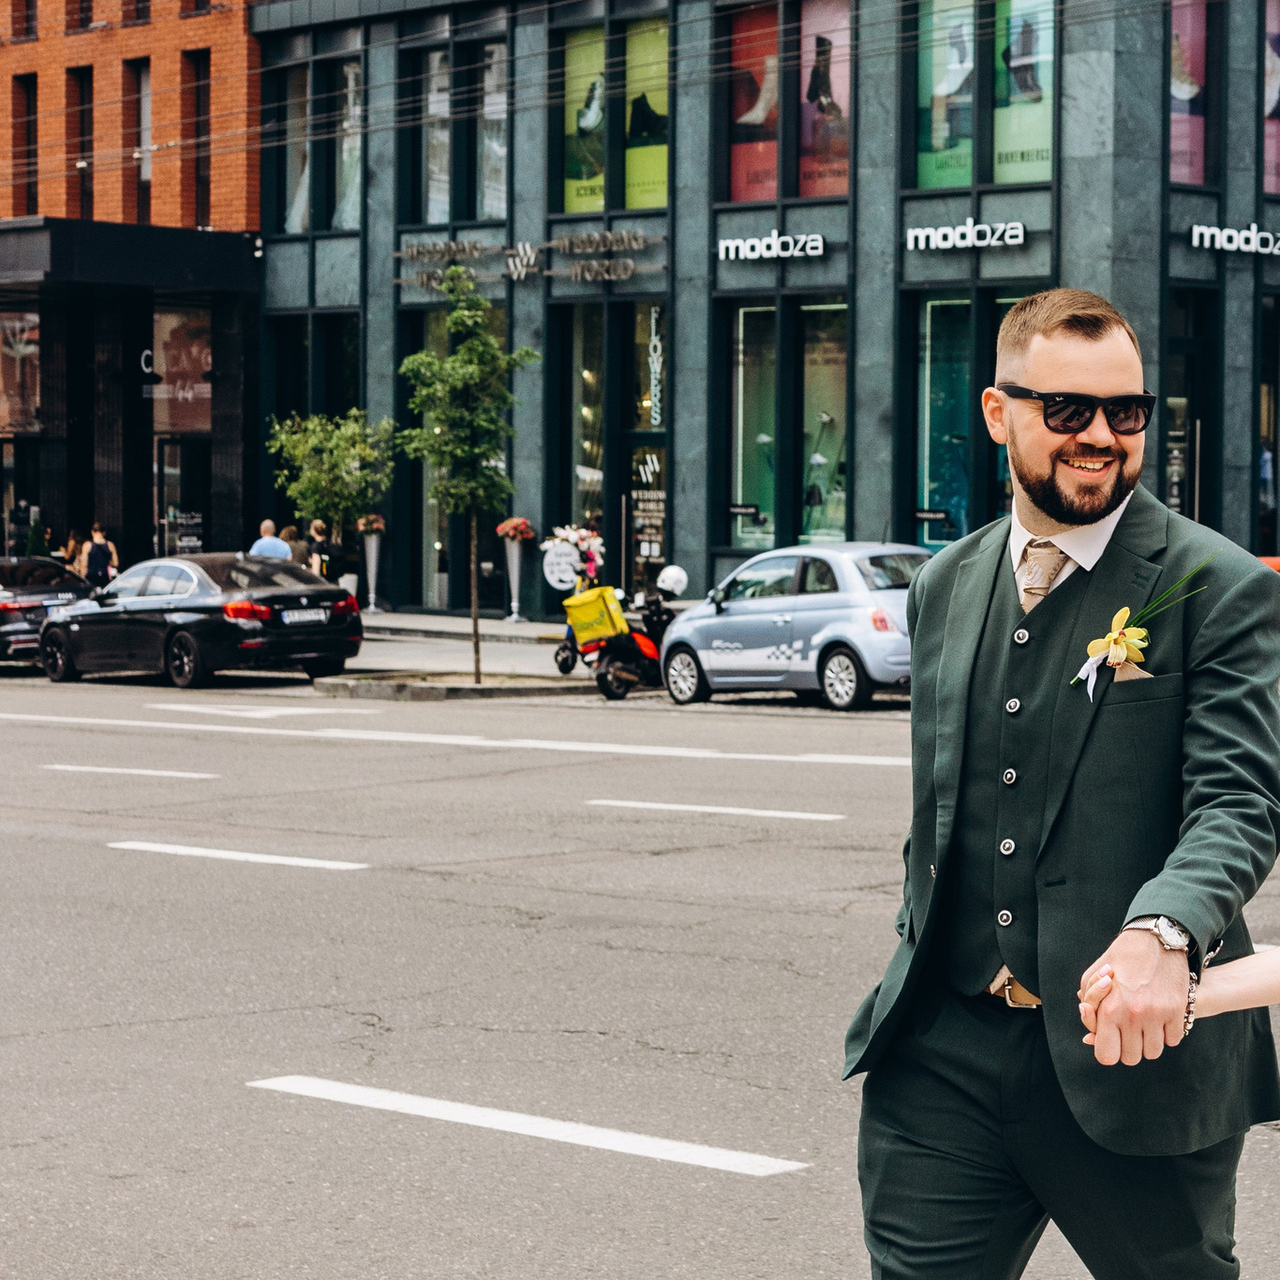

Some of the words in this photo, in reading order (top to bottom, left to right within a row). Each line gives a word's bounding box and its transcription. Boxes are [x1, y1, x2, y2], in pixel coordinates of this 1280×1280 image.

[556, 228, 645, 254] WEDDING
[718, 228, 824, 261] modoza
[906, 217, 1024, 251] modoza
[570, 258, 635, 284] WORLD
[648, 305, 663, 426] FLOWERS
